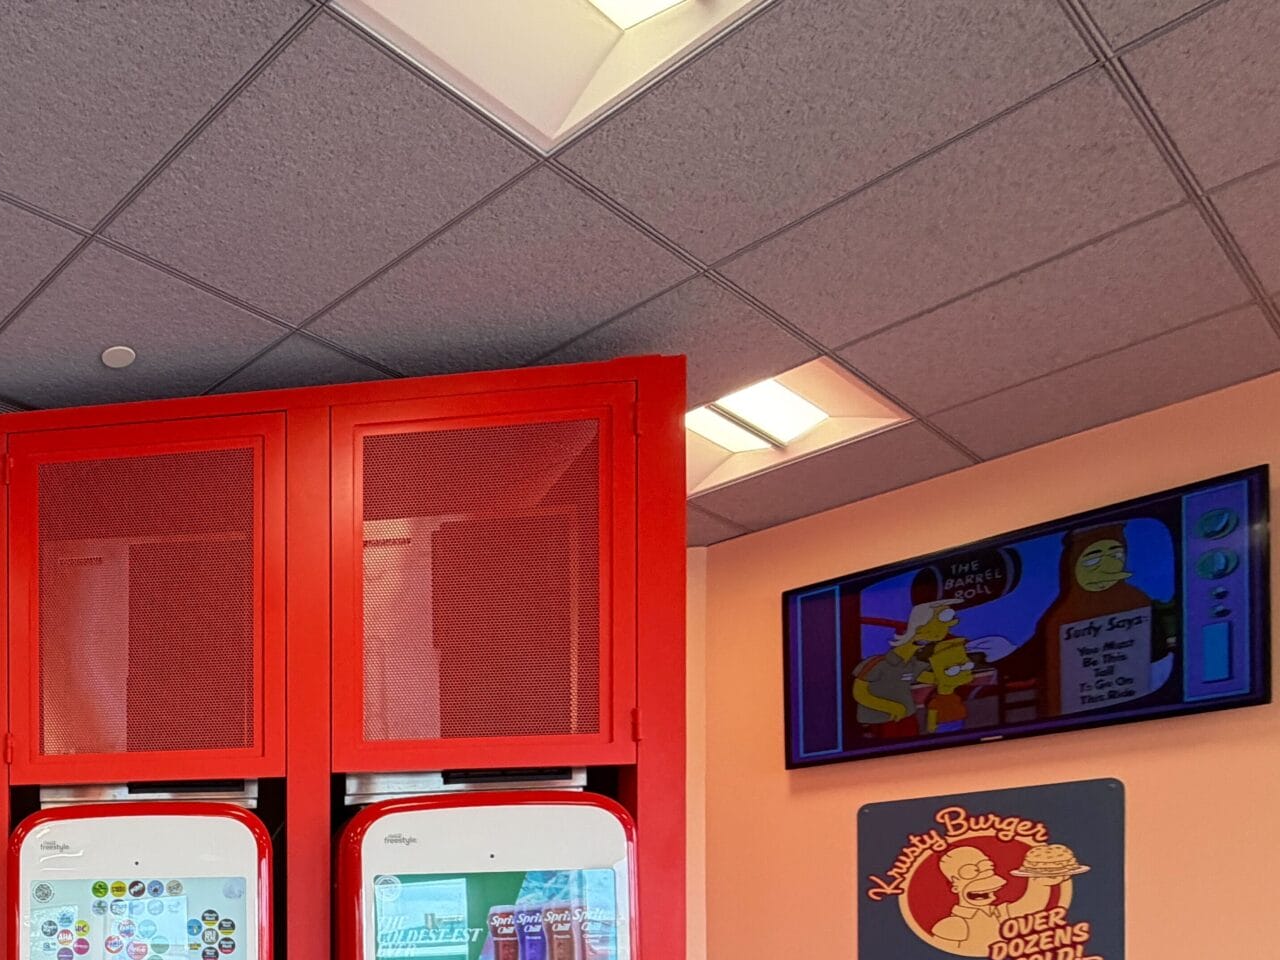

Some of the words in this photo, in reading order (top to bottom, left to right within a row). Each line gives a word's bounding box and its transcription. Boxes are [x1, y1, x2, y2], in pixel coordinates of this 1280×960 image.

[951, 560, 979, 574] THE
[945, 568, 1003, 590] BARREL
[954, 584, 992, 599] ROLL
[1082, 657, 1099, 668] Be
[867, 828, 947, 902] Krusty
[936, 807, 1049, 843] Burger
[1001, 908, 1067, 940] OVER
[989, 922, 1090, 960] DOZENS
